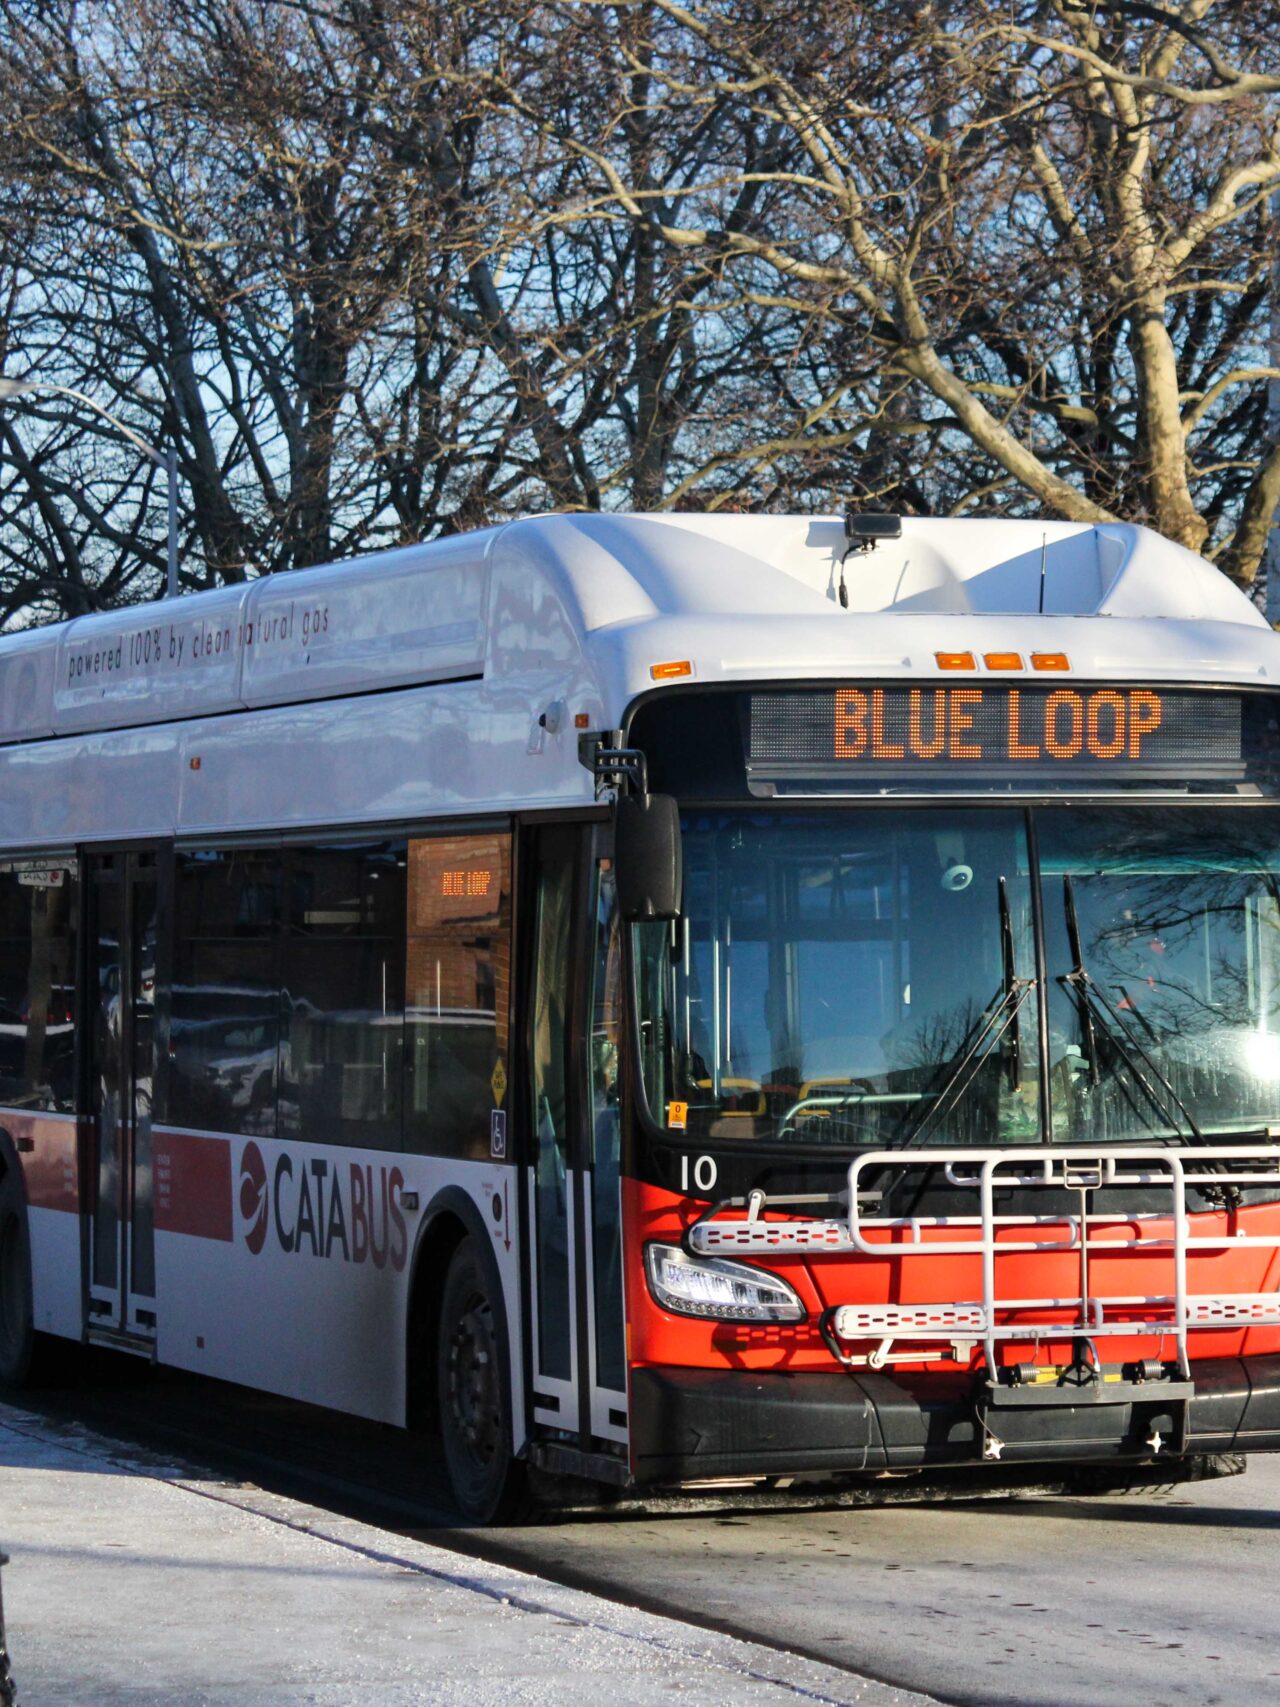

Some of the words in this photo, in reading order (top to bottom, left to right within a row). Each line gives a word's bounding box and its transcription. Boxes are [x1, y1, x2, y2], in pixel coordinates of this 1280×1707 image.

[69, 642, 121, 685] powered
[129, 628, 161, 668] 100%
[169, 623, 185, 666] by
[193, 619, 230, 658] clean
[303, 607, 329, 646] gas
[833, 689, 982, 759] BLUE
[1007, 689, 1163, 759] LOOP
[443, 871, 465, 896] BLUE
[467, 871, 491, 896] LOOP
[681, 1155, 717, 1191] 10
